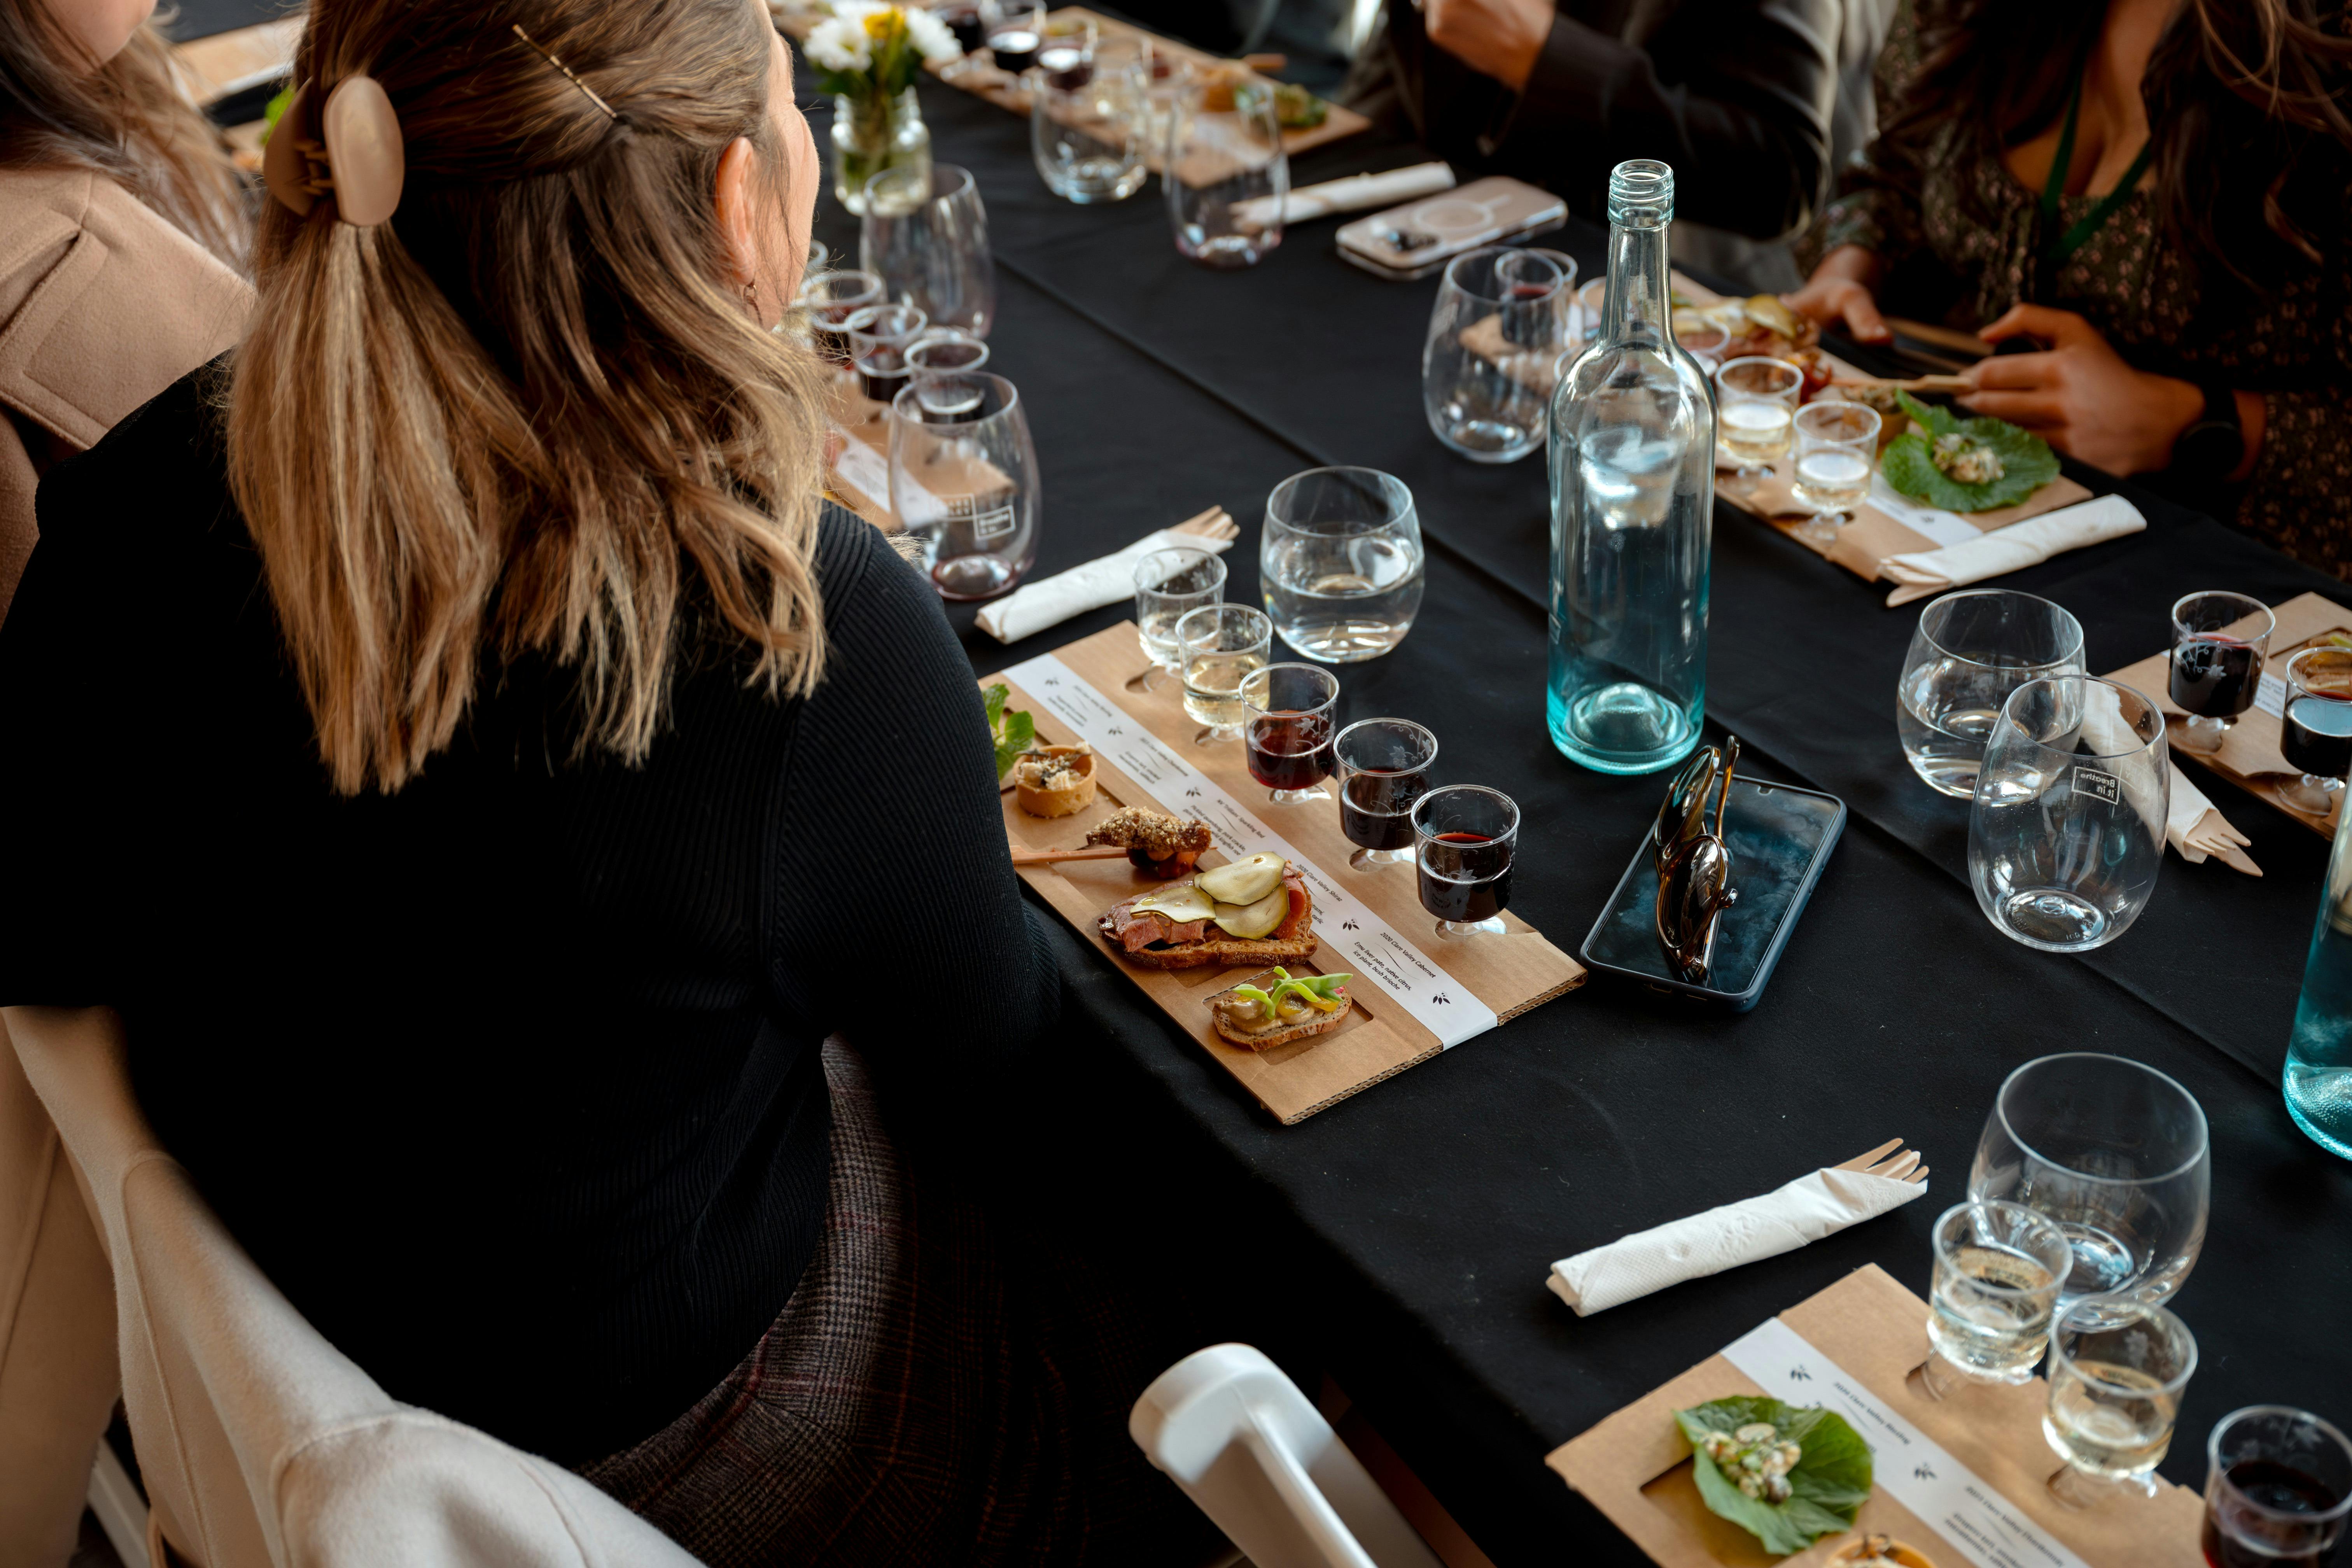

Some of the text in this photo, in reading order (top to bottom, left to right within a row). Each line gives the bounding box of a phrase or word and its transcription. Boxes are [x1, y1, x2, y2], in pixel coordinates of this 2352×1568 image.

[1297, 864, 1342, 901] 2020 Clare Valley Shiraz
[1354, 942, 1411, 990] Emu liver pate, native citrus,
[1358, 957, 1372, 967] plant,
[1372, 966, 1384, 976] bush
[1383, 975, 1400, 990] brioche
[1380, 933, 1435, 978] 2020 Clare Valley Cabernet
